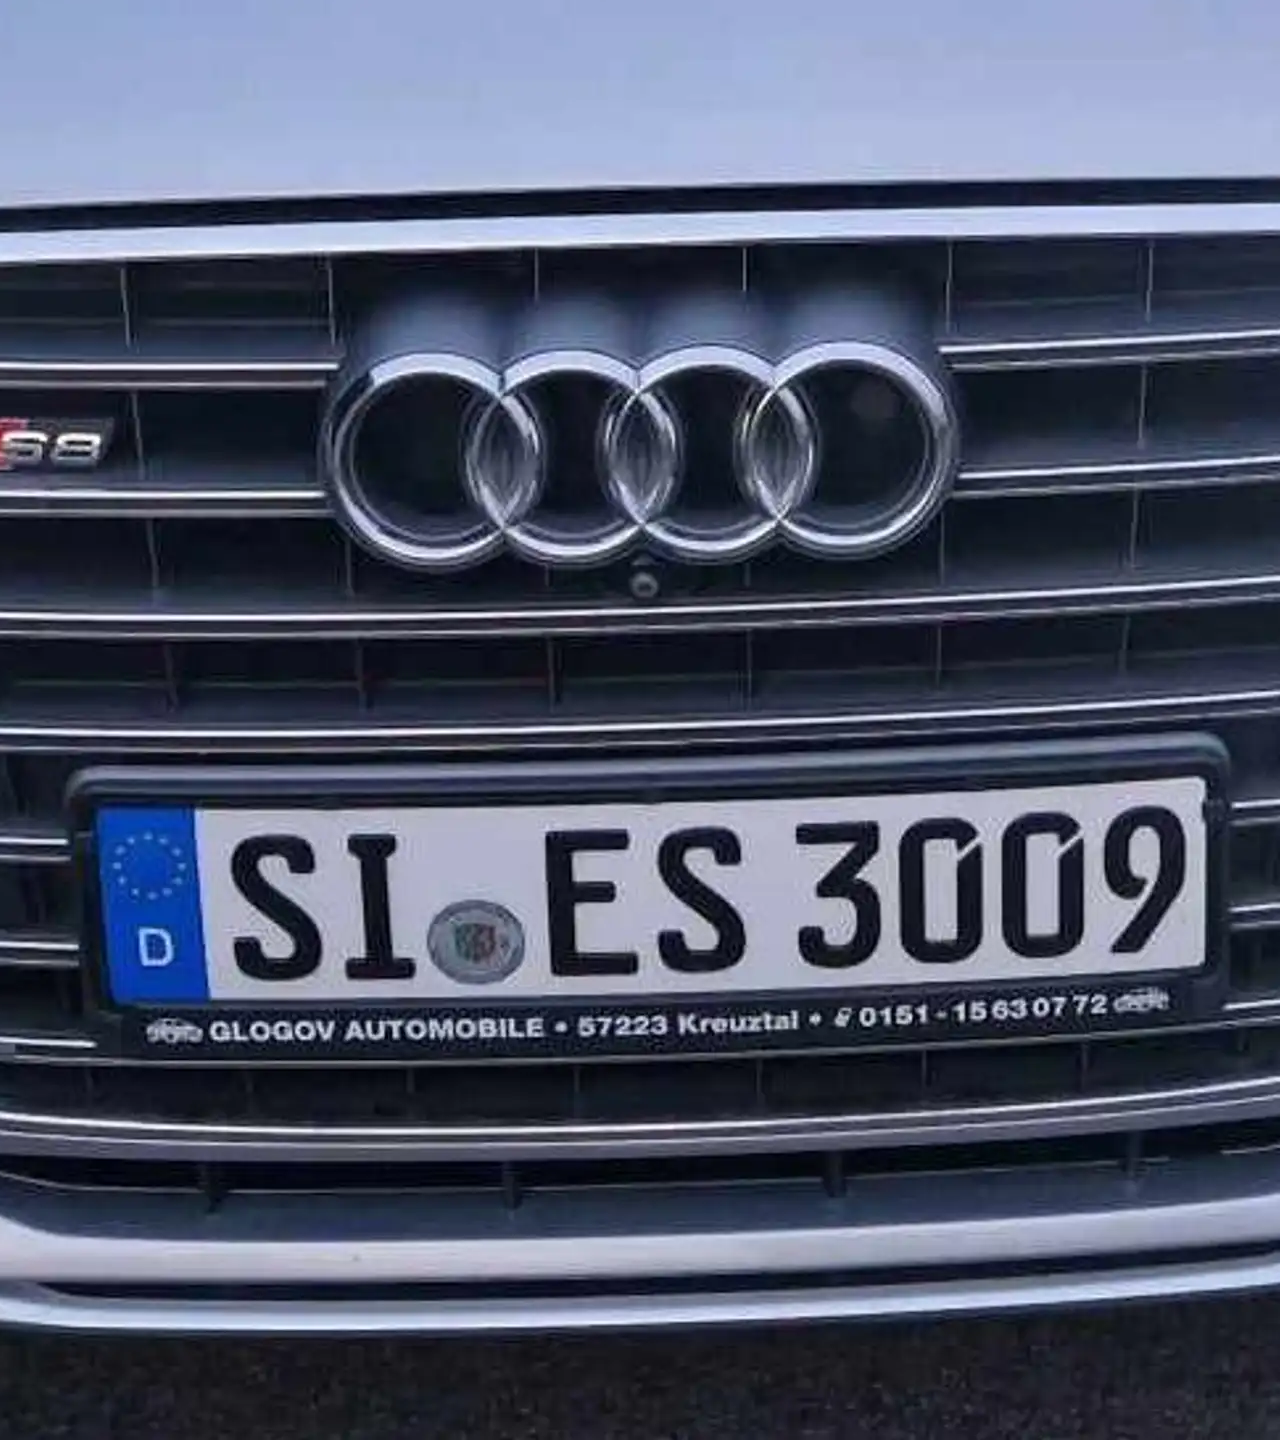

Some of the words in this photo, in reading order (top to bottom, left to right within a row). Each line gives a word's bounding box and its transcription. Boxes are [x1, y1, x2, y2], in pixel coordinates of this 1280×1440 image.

[230, 833, 417, 981] SI
[545, 826, 746, 976] ES
[795, 805, 1187, 969] 3009
[138, 926, 174, 967] D
[209, 1019, 336, 1042] GLOGOV
[344, 1017, 545, 1041] AUTOMOBILE
[577, 1014, 669, 1038] 57223
[677, 1010, 800, 1036] Kreuztal
